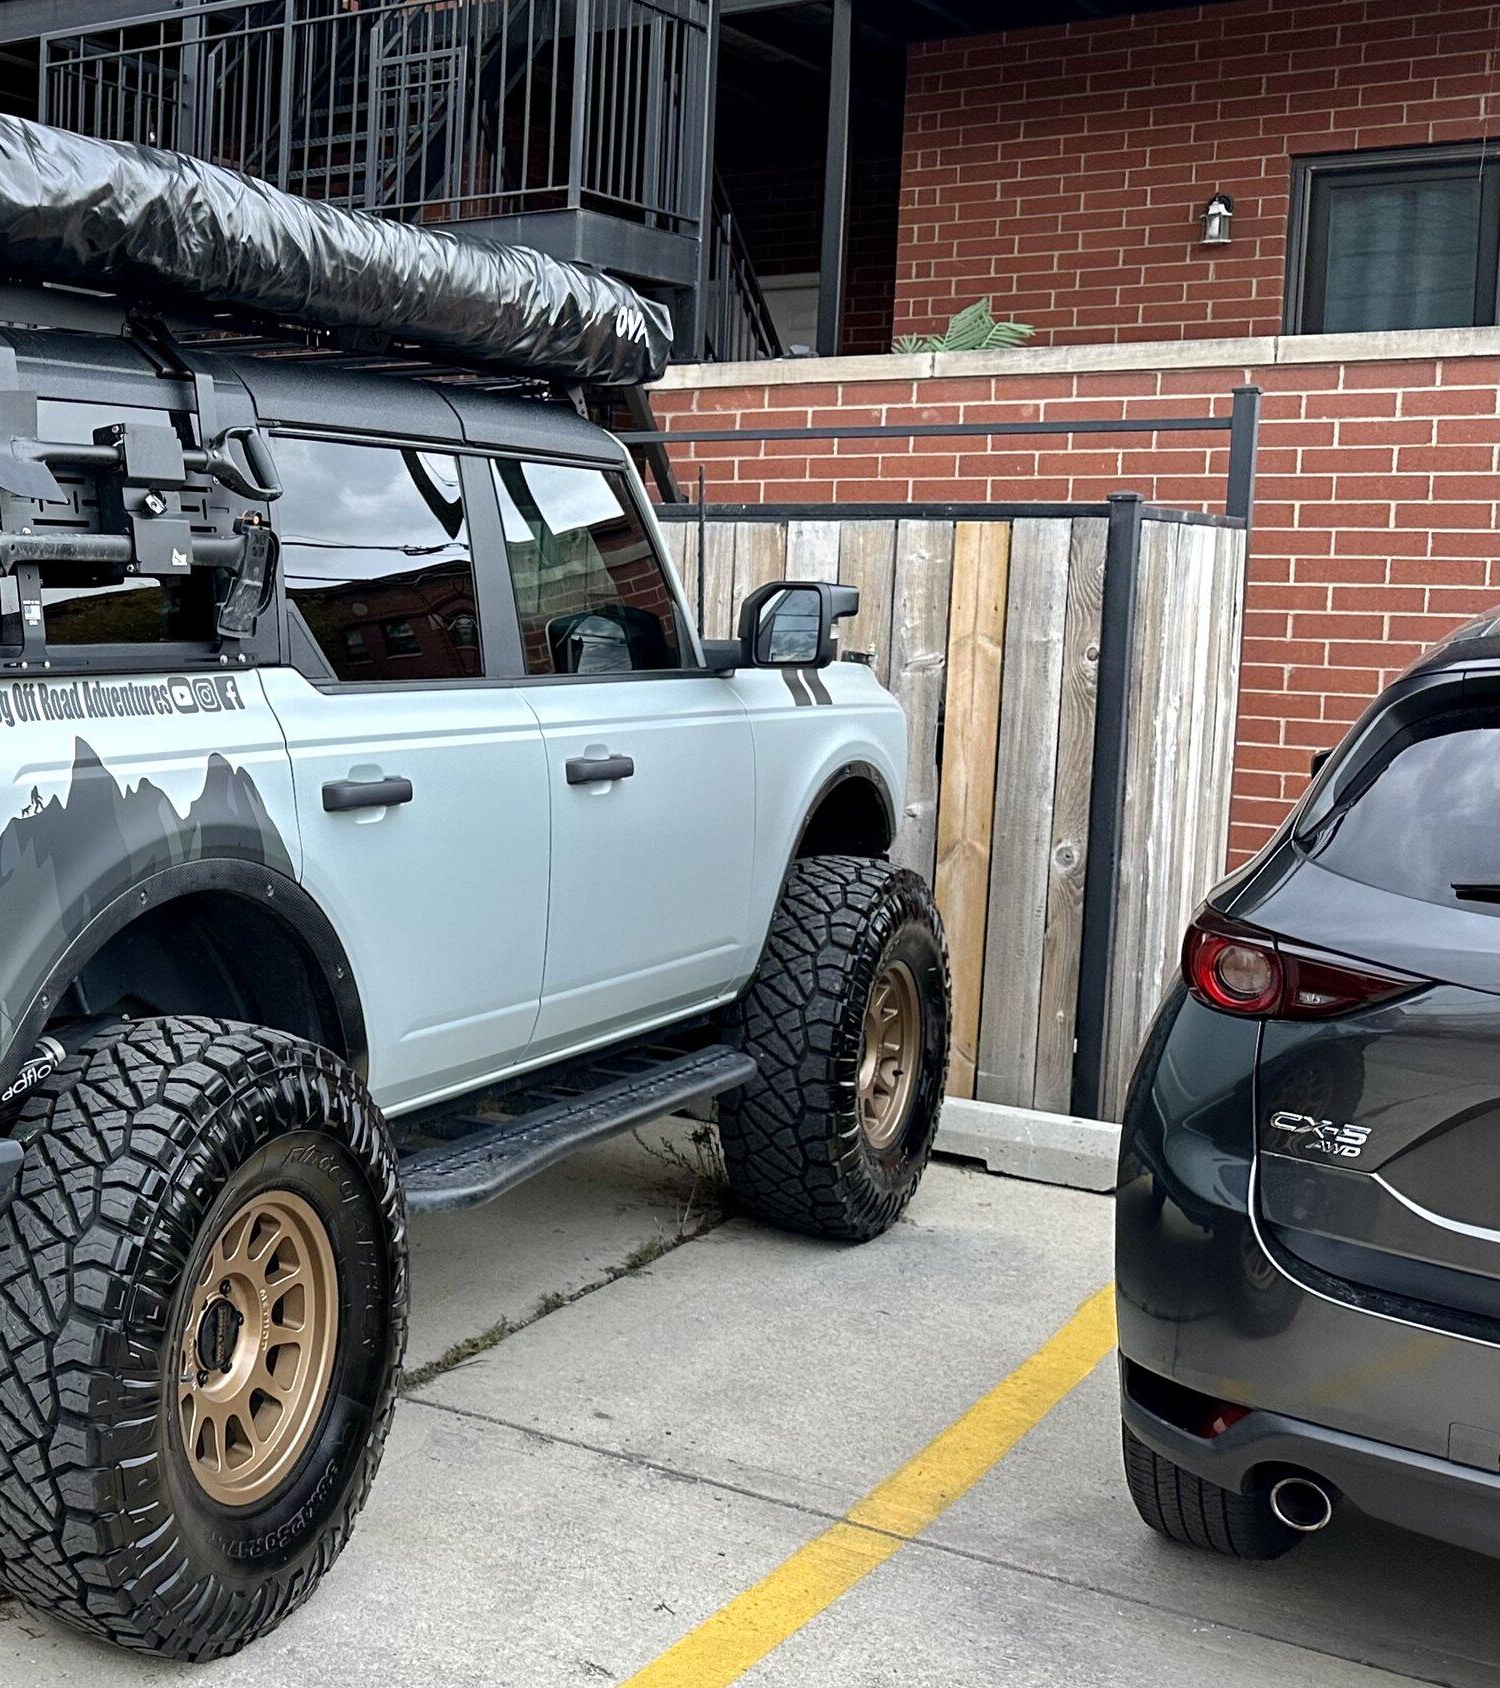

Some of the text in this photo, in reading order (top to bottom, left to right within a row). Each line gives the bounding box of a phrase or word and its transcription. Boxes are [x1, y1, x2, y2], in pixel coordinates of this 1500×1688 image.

[12, 682, 41, 722] Off
[37, 681, 86, 721] Road
[80, 680, 174, 719] Adventures
[1270, 1111, 1372, 1145] CX-5
[1305, 1140, 1361, 1157] AWD
